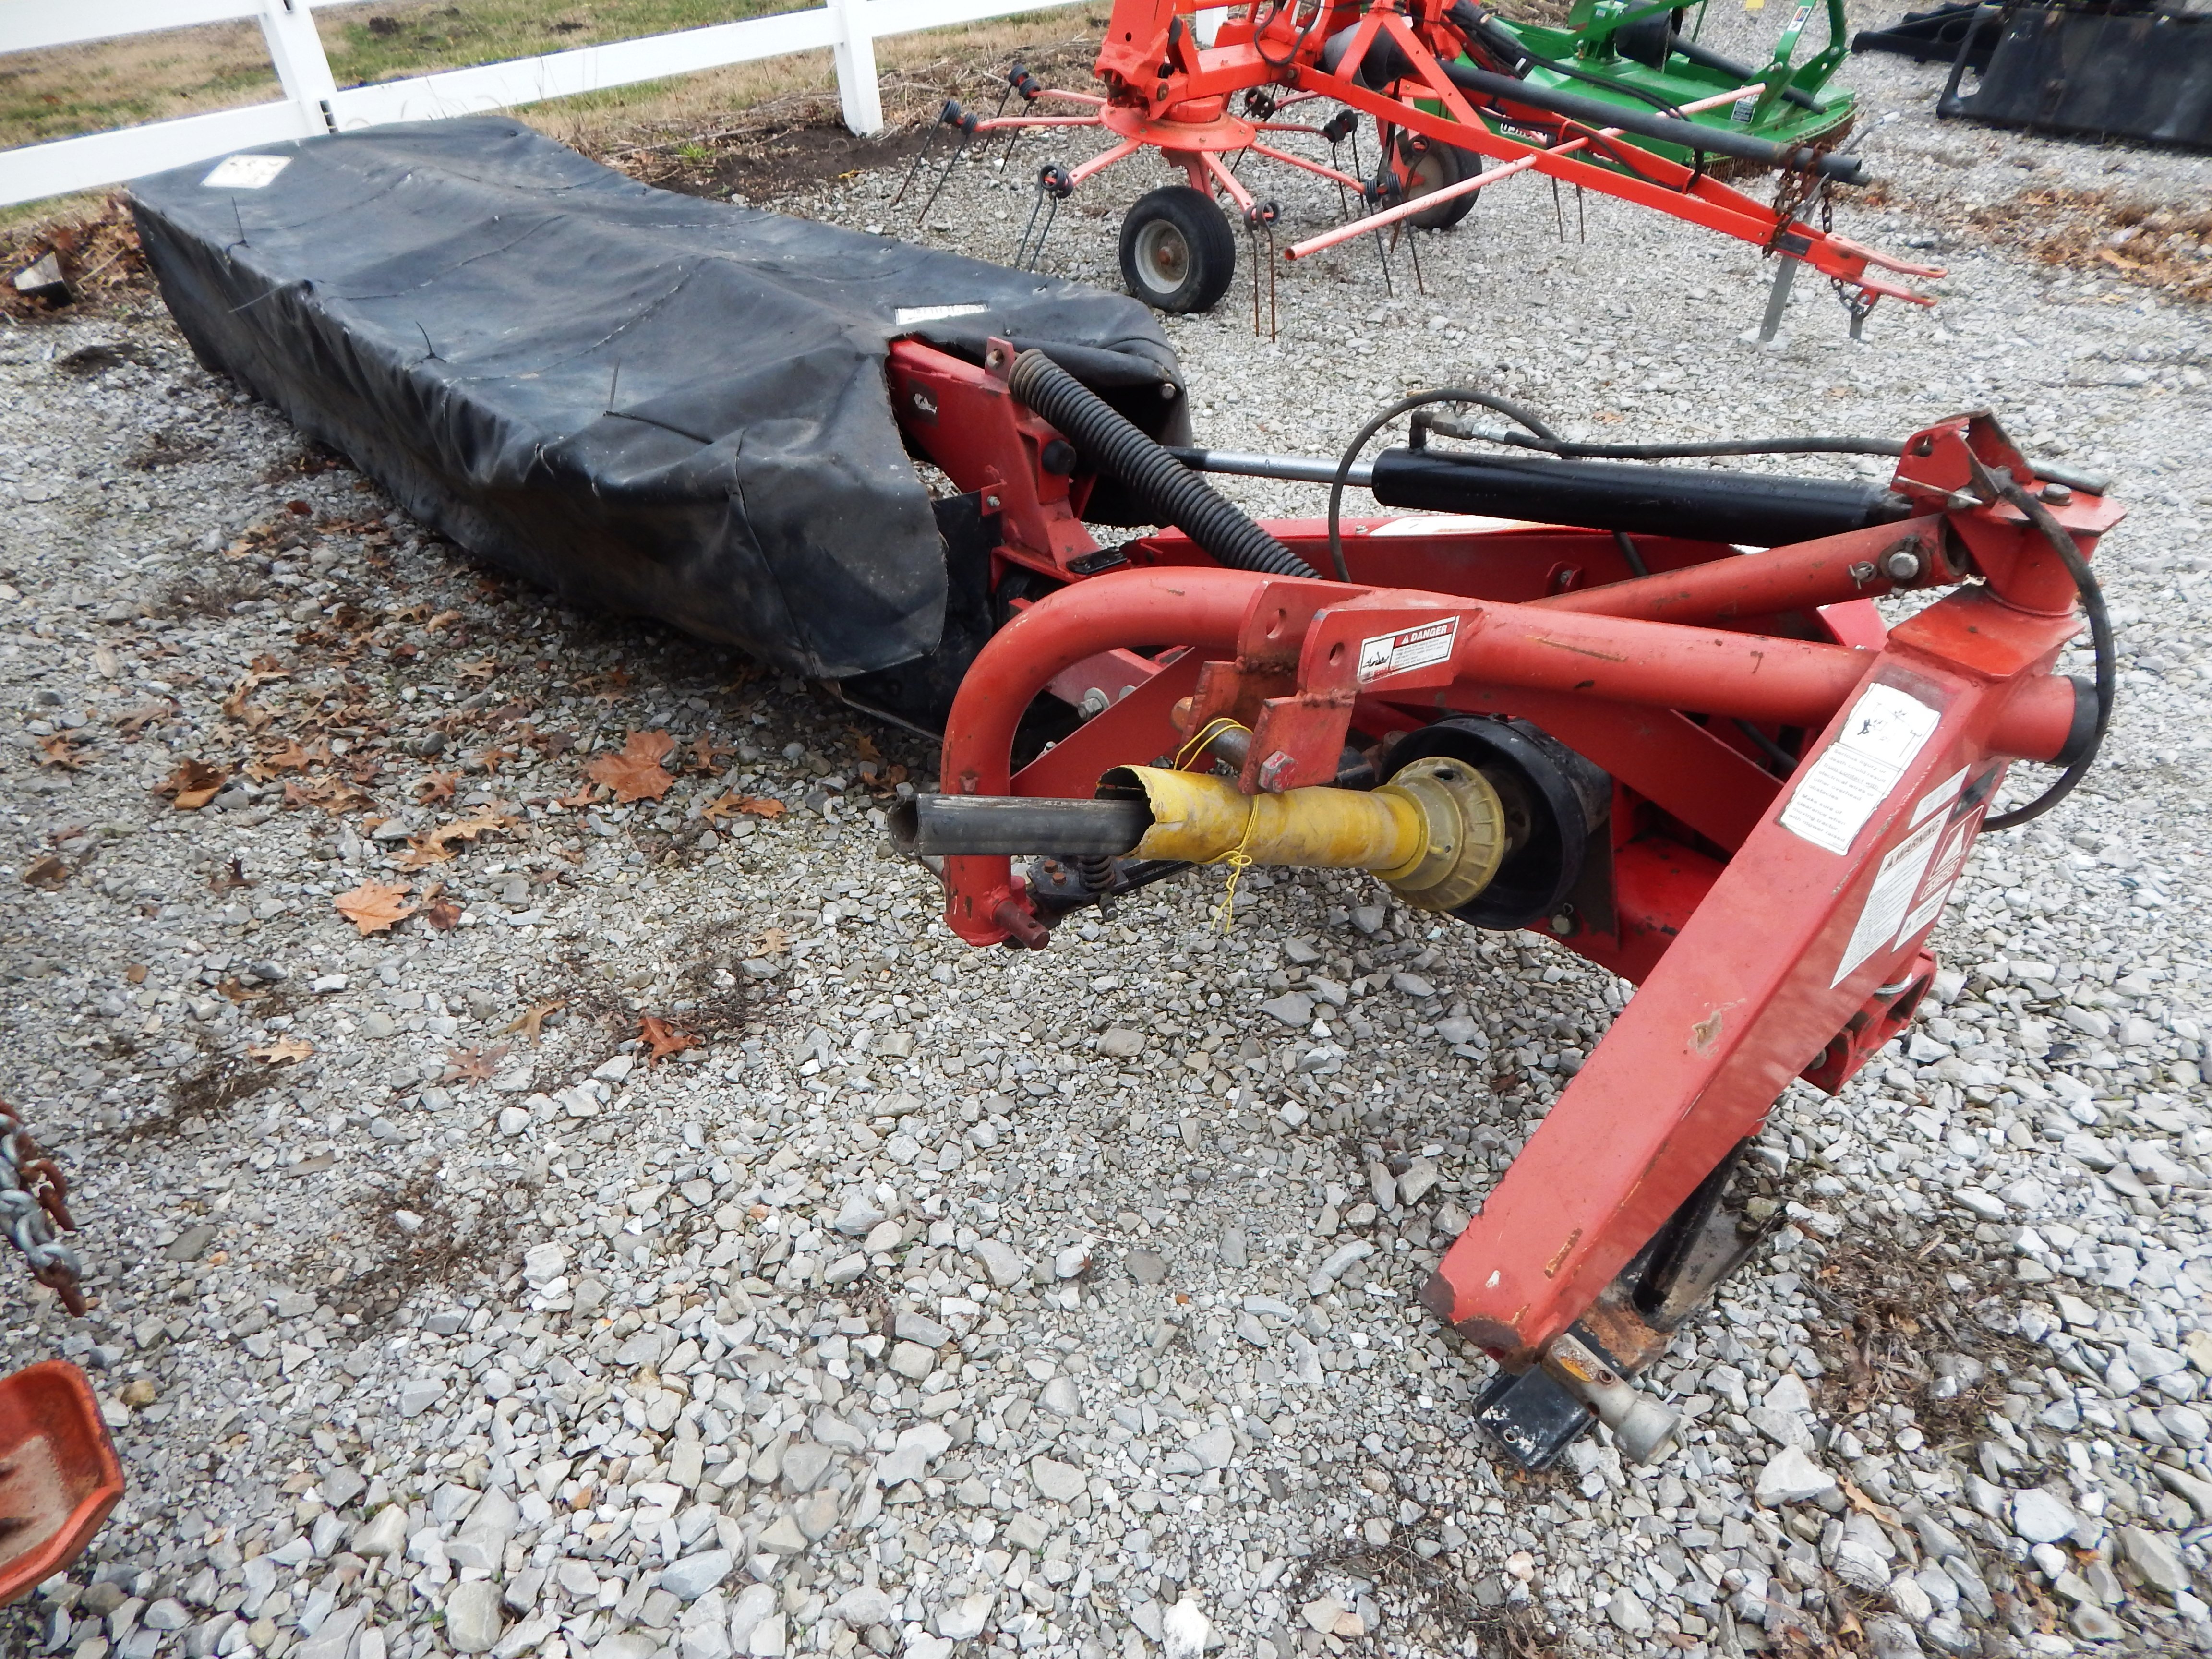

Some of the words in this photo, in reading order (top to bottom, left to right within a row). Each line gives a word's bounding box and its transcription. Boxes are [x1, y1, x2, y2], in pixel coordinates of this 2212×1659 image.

[1410, 625, 1448, 642] DANGER
[1828, 755, 1847, 766] death
[1847, 764, 1867, 775] could
[1866, 772, 1886, 783] result
[1833, 748, 1859, 762] Serious
[1858, 759, 1878, 771] injury
[1817, 769, 1848, 785] electrical
[1848, 783, 1866, 794] wires
[1823, 762, 1839, 772] from
[1839, 769, 1864, 783] contact
[1864, 781, 1879, 791] with
[1813, 777, 1830, 787] other
[1830, 784, 1862, 801] overhead
[1791, 806, 1816, 821] moving
[1796, 800, 1827, 817] clearance
[1827, 815, 1846, 826] when
[1801, 793, 1819, 804] Make
[1818, 802, 1834, 811] sure
[1788, 813, 1802, 822] with
[1802, 819, 1824, 832] mower
[1824, 830, 1846, 842] raised
